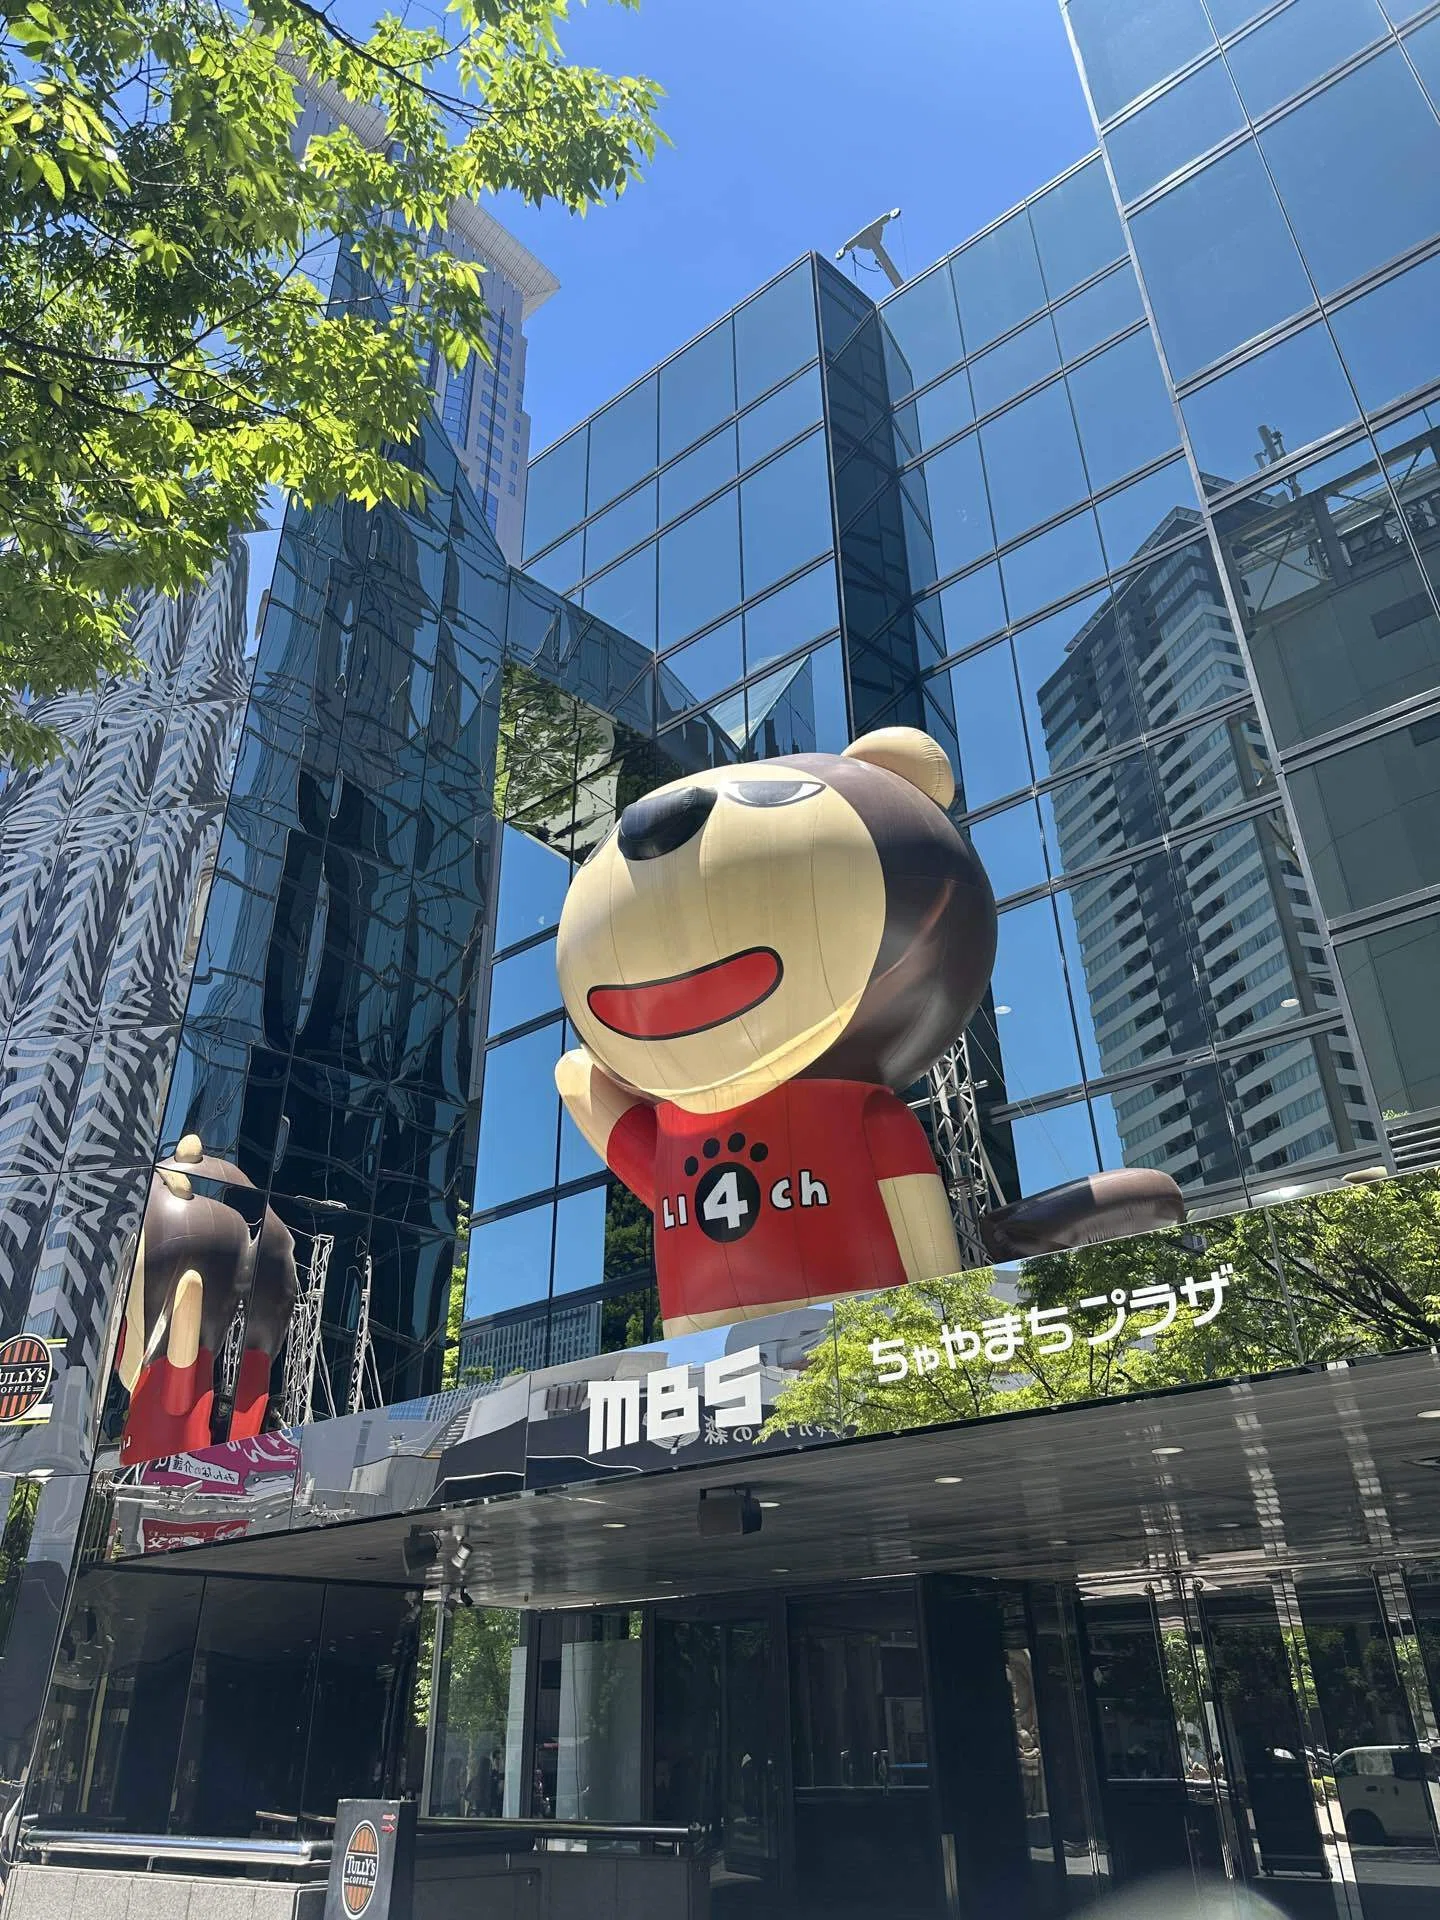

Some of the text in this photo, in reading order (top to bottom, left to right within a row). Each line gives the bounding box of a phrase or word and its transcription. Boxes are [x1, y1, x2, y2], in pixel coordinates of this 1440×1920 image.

[770, 1169, 830, 1210] ch
[587, 1263, 1233, 1455] MBS ちゃやまちプラザ
[0, 1366, 46, 1385] ULLY'S
[0, 1385, 32, 1394] OFFEE
[346, 1855, 376, 1877] TULLY'S
[349, 1876, 369, 1886] COFFEE
